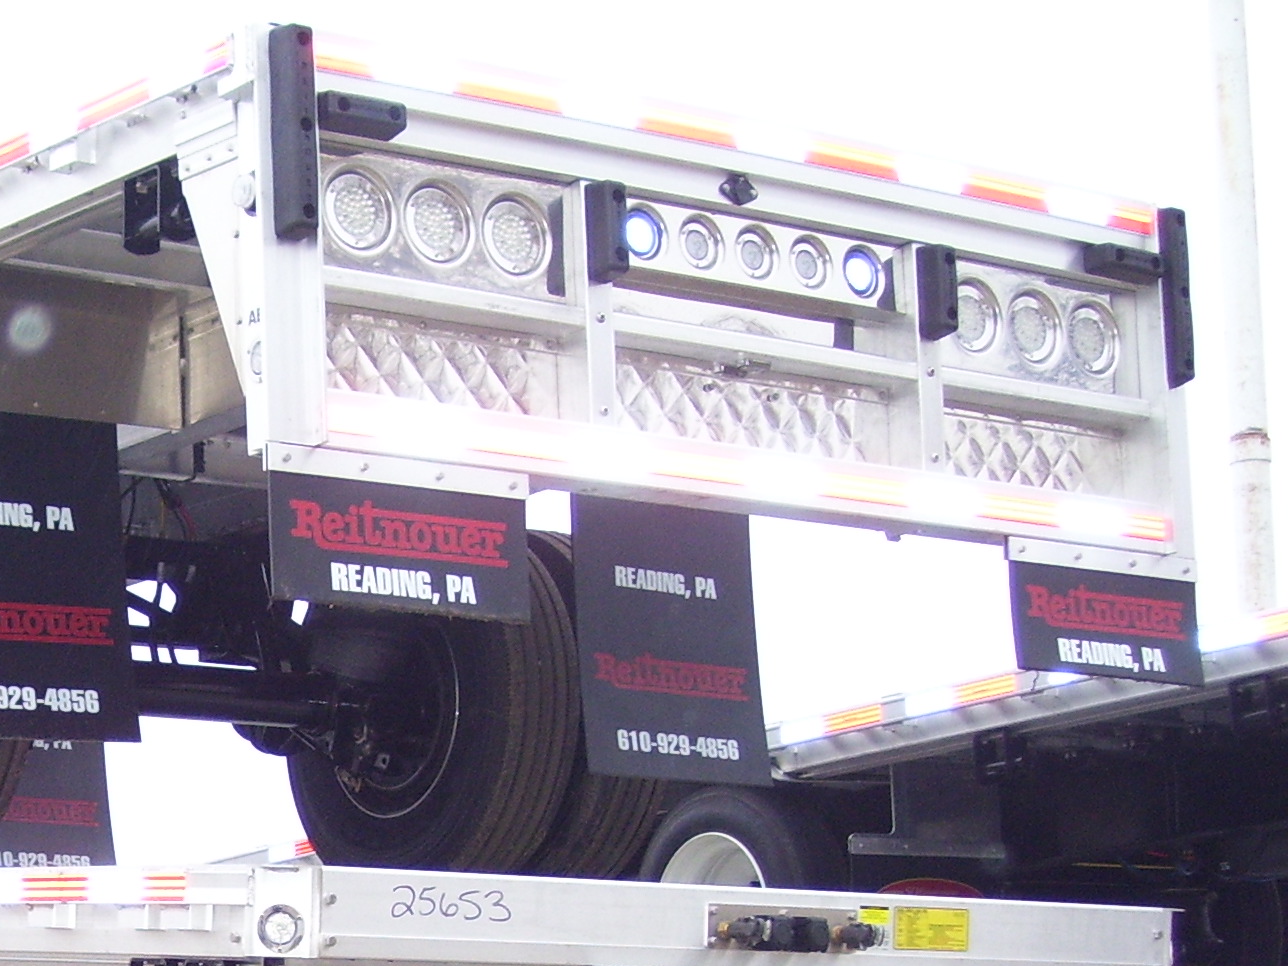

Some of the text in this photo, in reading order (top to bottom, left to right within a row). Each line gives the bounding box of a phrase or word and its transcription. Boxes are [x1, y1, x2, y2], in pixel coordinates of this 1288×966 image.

[46, 506, 74, 531] PA
[289, 500, 509, 568] Reitnouer
[331, 562, 477, 604] READING, PA
[614, 565, 717, 599] READING, PA
[1057, 638, 1166, 673] READING, PA
[617, 729, 739, 760] 610-929-4856
[391, 885, 512, 922] 25653
